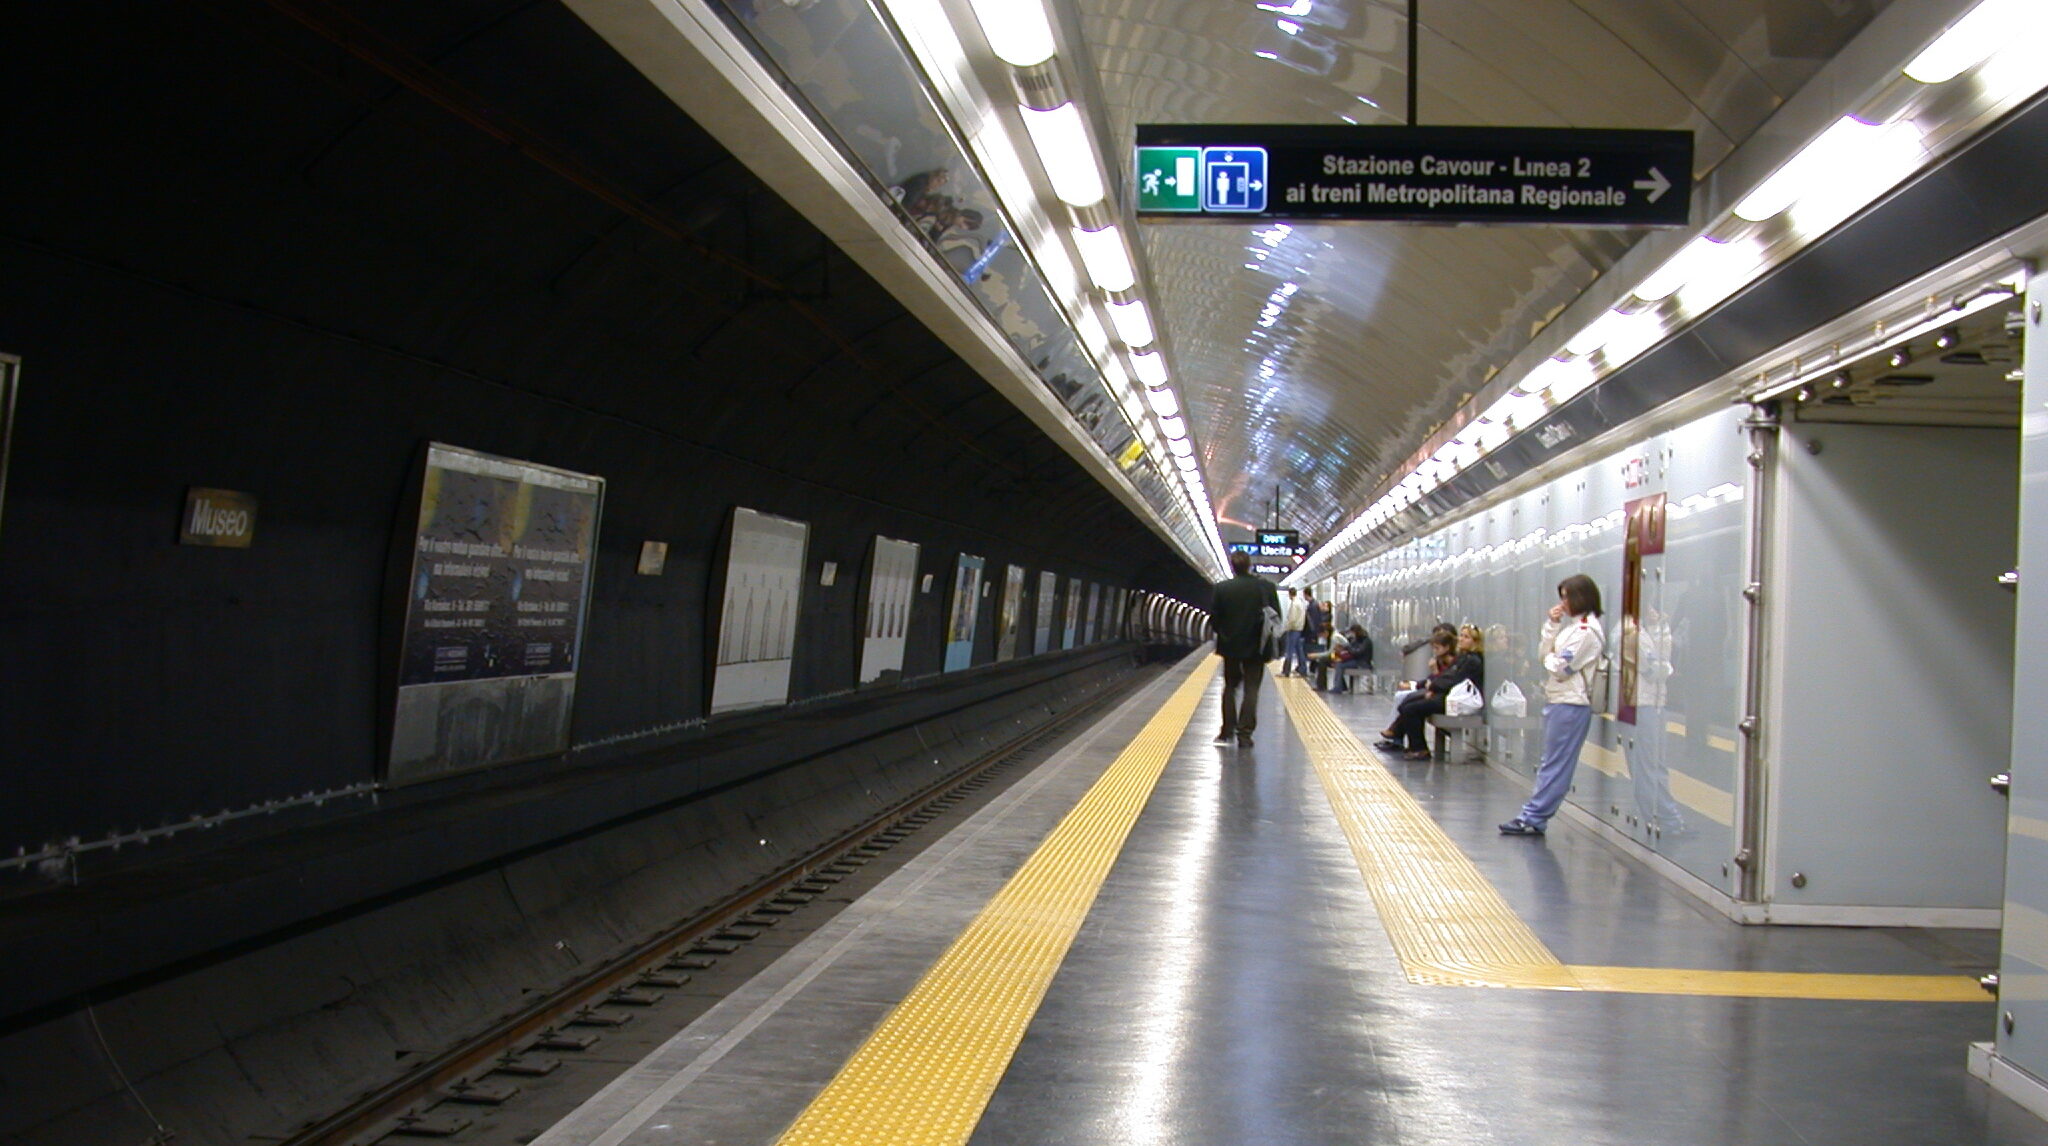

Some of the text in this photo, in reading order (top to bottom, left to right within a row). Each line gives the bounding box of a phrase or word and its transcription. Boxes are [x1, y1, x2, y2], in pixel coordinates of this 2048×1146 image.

[1323, 155, 1414, 175] Stazione
[1421, 155, 1494, 176] Cavour
[1578, 158, 1591, 176] 2
[1286, 183, 1626, 210] ai treni Metropolitana Regionale
[190, 498, 248, 537] Museo
[1260, 545, 1293, 556] Uscita
